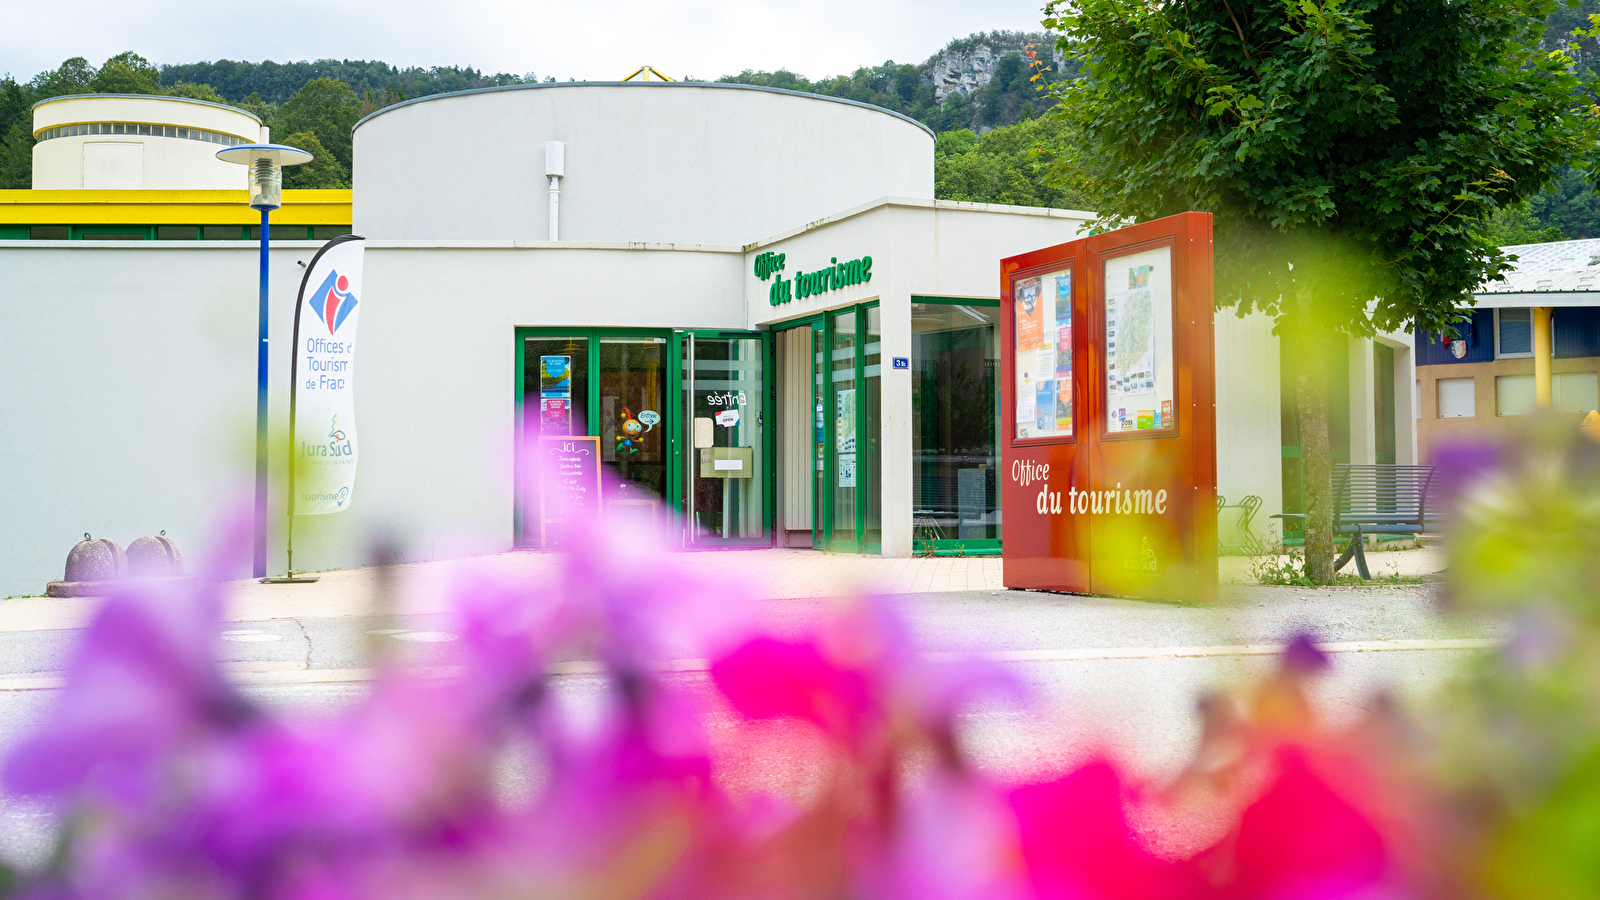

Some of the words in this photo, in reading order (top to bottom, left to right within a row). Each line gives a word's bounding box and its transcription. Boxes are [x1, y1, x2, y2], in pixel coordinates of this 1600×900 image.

[754, 252, 786, 281] Office
[769, 274, 792, 306] du
[794, 256, 873, 300] tourisme
[307, 338, 344, 354] Offices
[896, 359, 901, 367] 3
[305, 379, 316, 390] de
[301, 441, 327, 459] Jura
[329, 440, 353, 457] Sud
[1011, 459, 1050, 487] Office
[1036, 484, 1062, 515] du
[1068, 482, 1168, 515] tourisme
[1123, 556, 1139, 570] Jura
[1140, 556, 1157, 571] Sud
